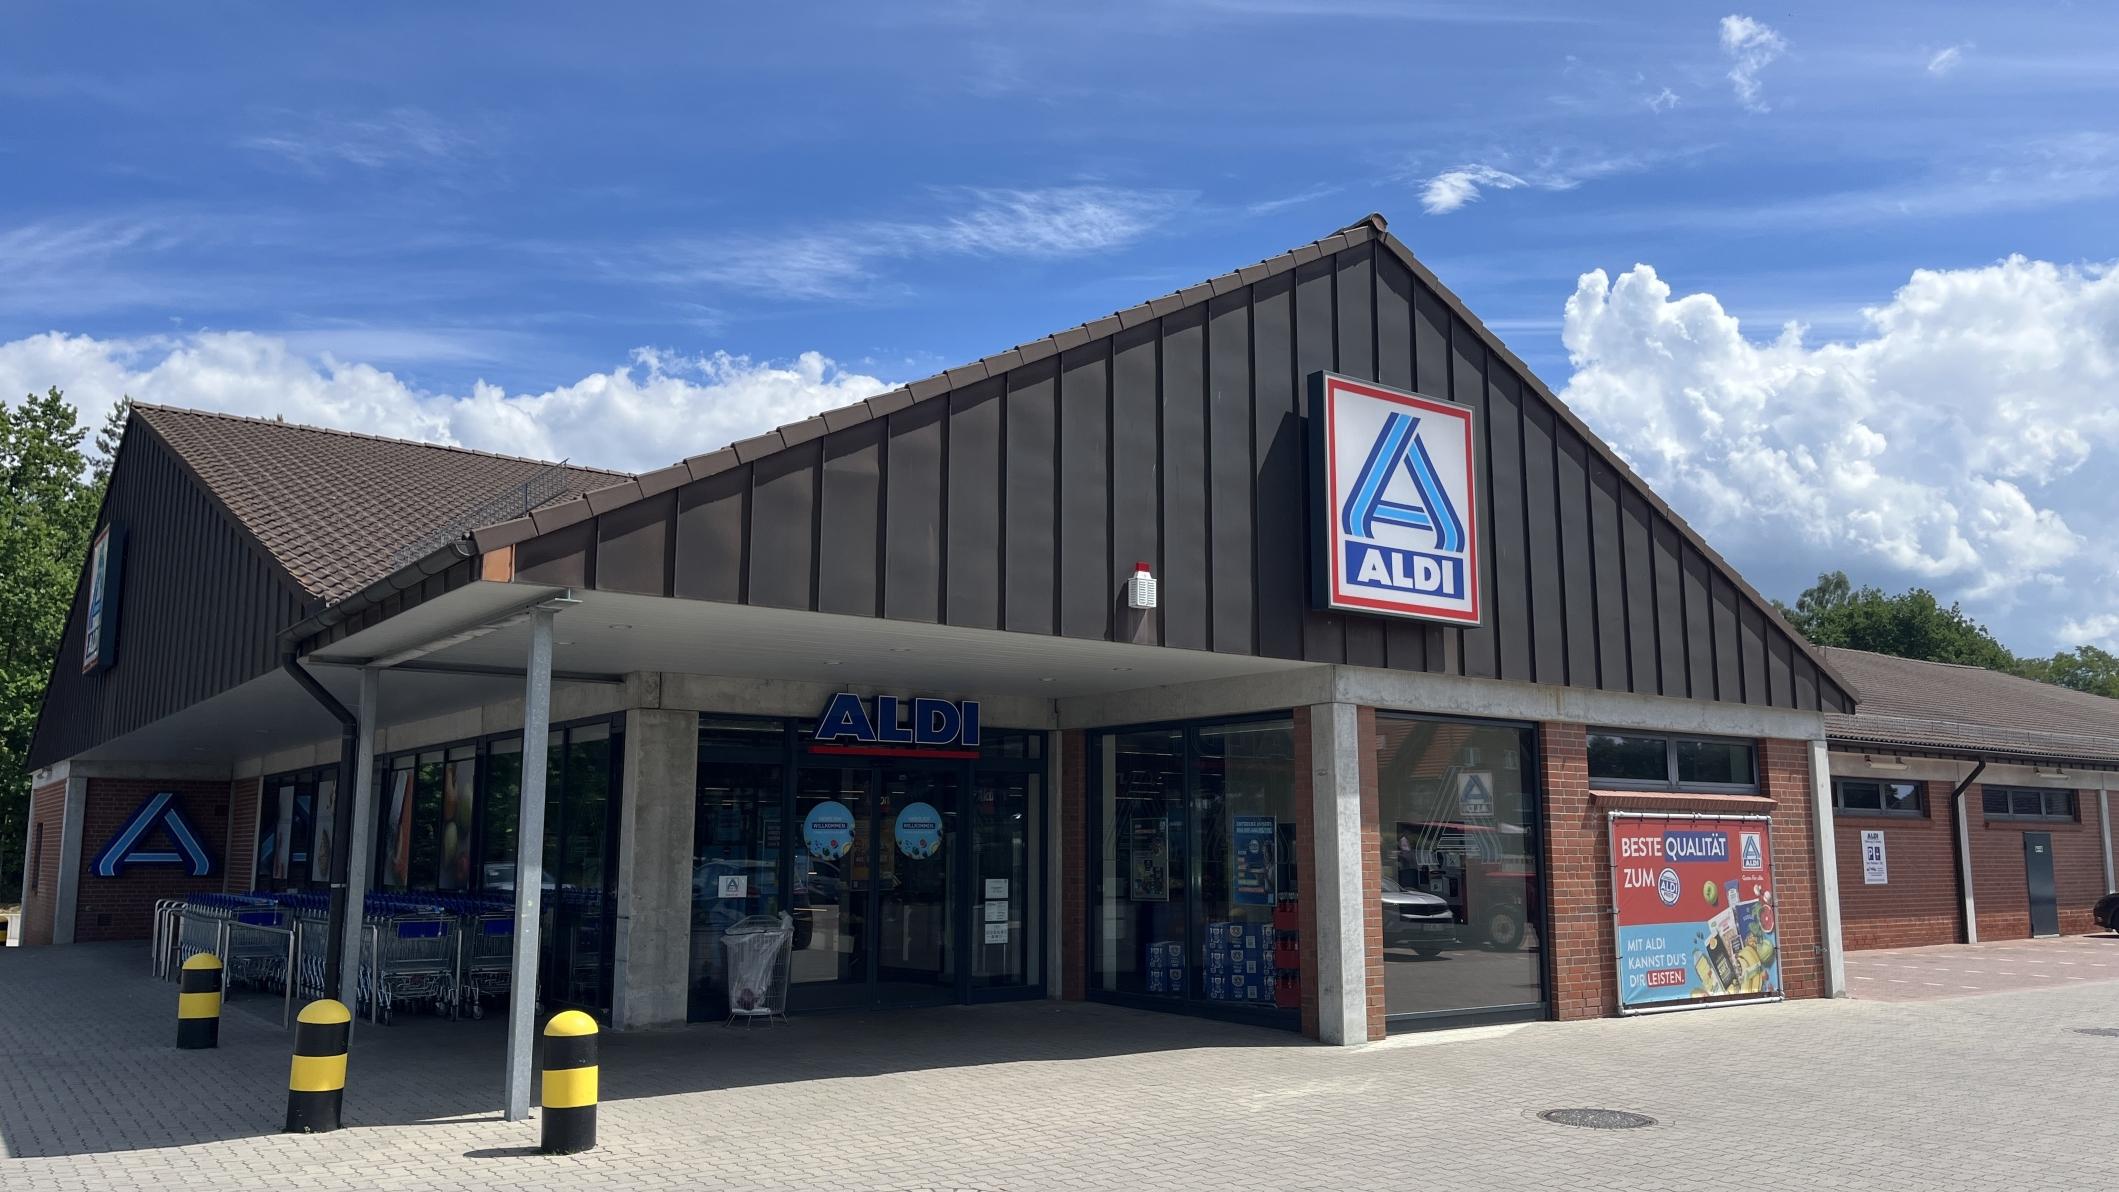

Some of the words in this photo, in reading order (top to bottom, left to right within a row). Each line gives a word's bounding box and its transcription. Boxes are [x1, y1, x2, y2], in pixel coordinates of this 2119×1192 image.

[1357, 548, 1455, 595] ALDI
[815, 692, 981, 746] ALDI
[1621, 837, 1662, 857] BESTE
[1665, 833, 1726, 861] QUALITÄT
[1623, 868, 1655, 888] ZUM
[1660, 880, 1678, 894] ALDI
[1627, 938, 1643, 951] MIT
[1645, 937, 1666, 950] ALDI
[1628, 954, 1665, 970] KANNST
[1666, 952, 1687, 967] DU'S
[1629, 974, 1646, 988] DIR
[1647, 970, 1685, 986] LEISTEN.
